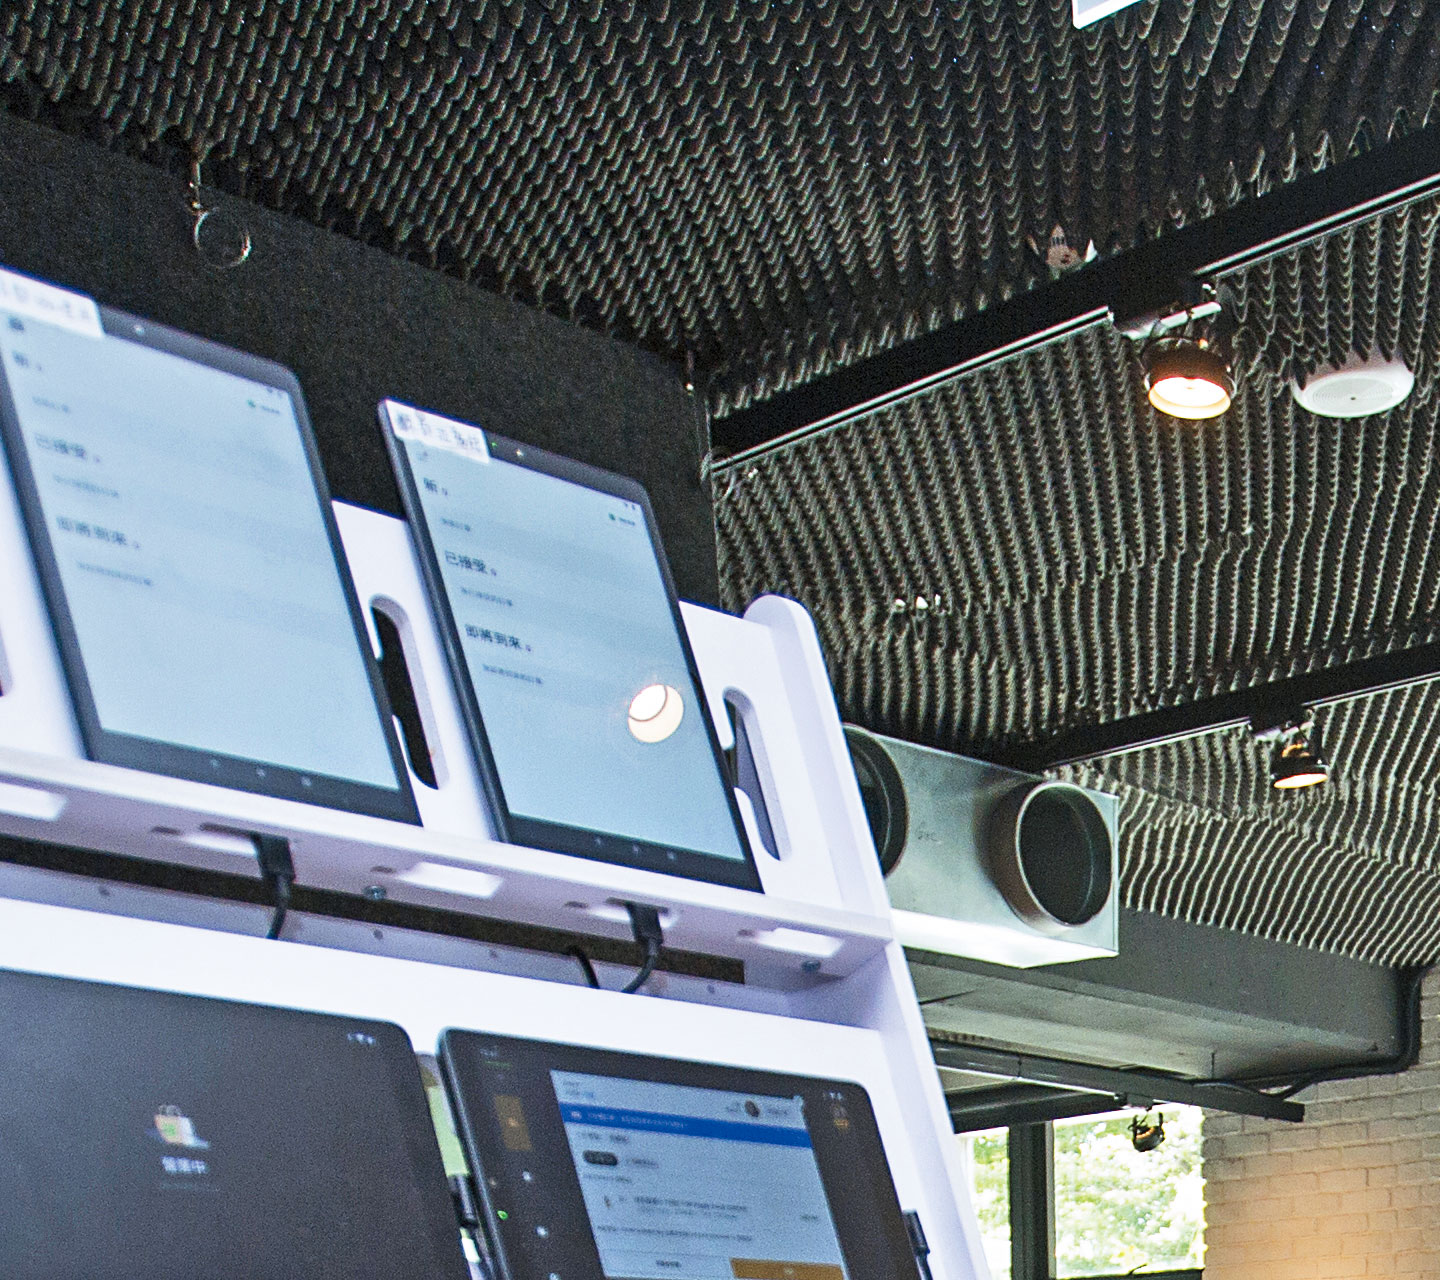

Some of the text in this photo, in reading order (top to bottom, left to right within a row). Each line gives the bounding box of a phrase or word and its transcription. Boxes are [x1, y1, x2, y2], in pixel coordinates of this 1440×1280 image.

[445, 550, 488, 574] 已接受
[465, 623, 522, 650] 即將到來
